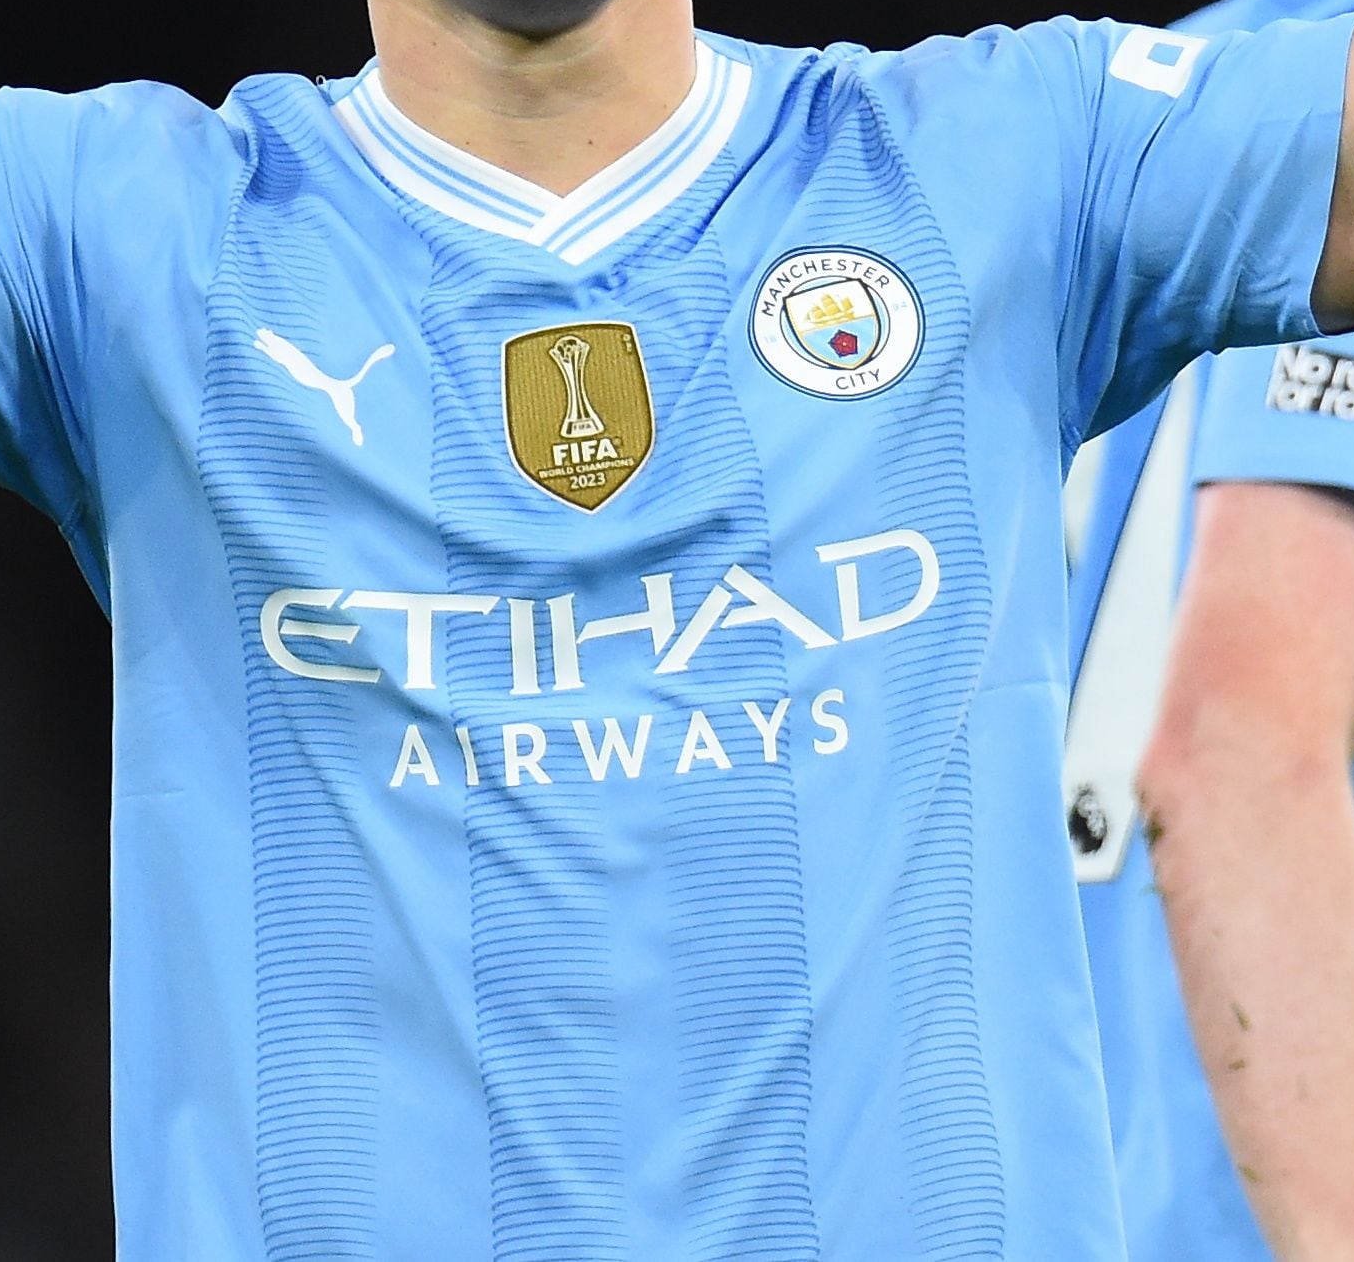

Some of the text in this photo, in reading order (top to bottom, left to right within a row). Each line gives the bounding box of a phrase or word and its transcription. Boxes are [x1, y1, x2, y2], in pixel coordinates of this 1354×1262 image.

[761, 258, 890, 317] MANCHESTER
[835, 368, 880, 390] CITY
[1269, 343, 1334, 386] No
[538, 457, 635, 479] WORLD CHAMPIONS
[552, 437, 619, 467] FIFA
[569, 472, 606, 490] 2023
[260, 529, 940, 696] ETIHAD
[388, 688, 849, 788] AIRWAYS
